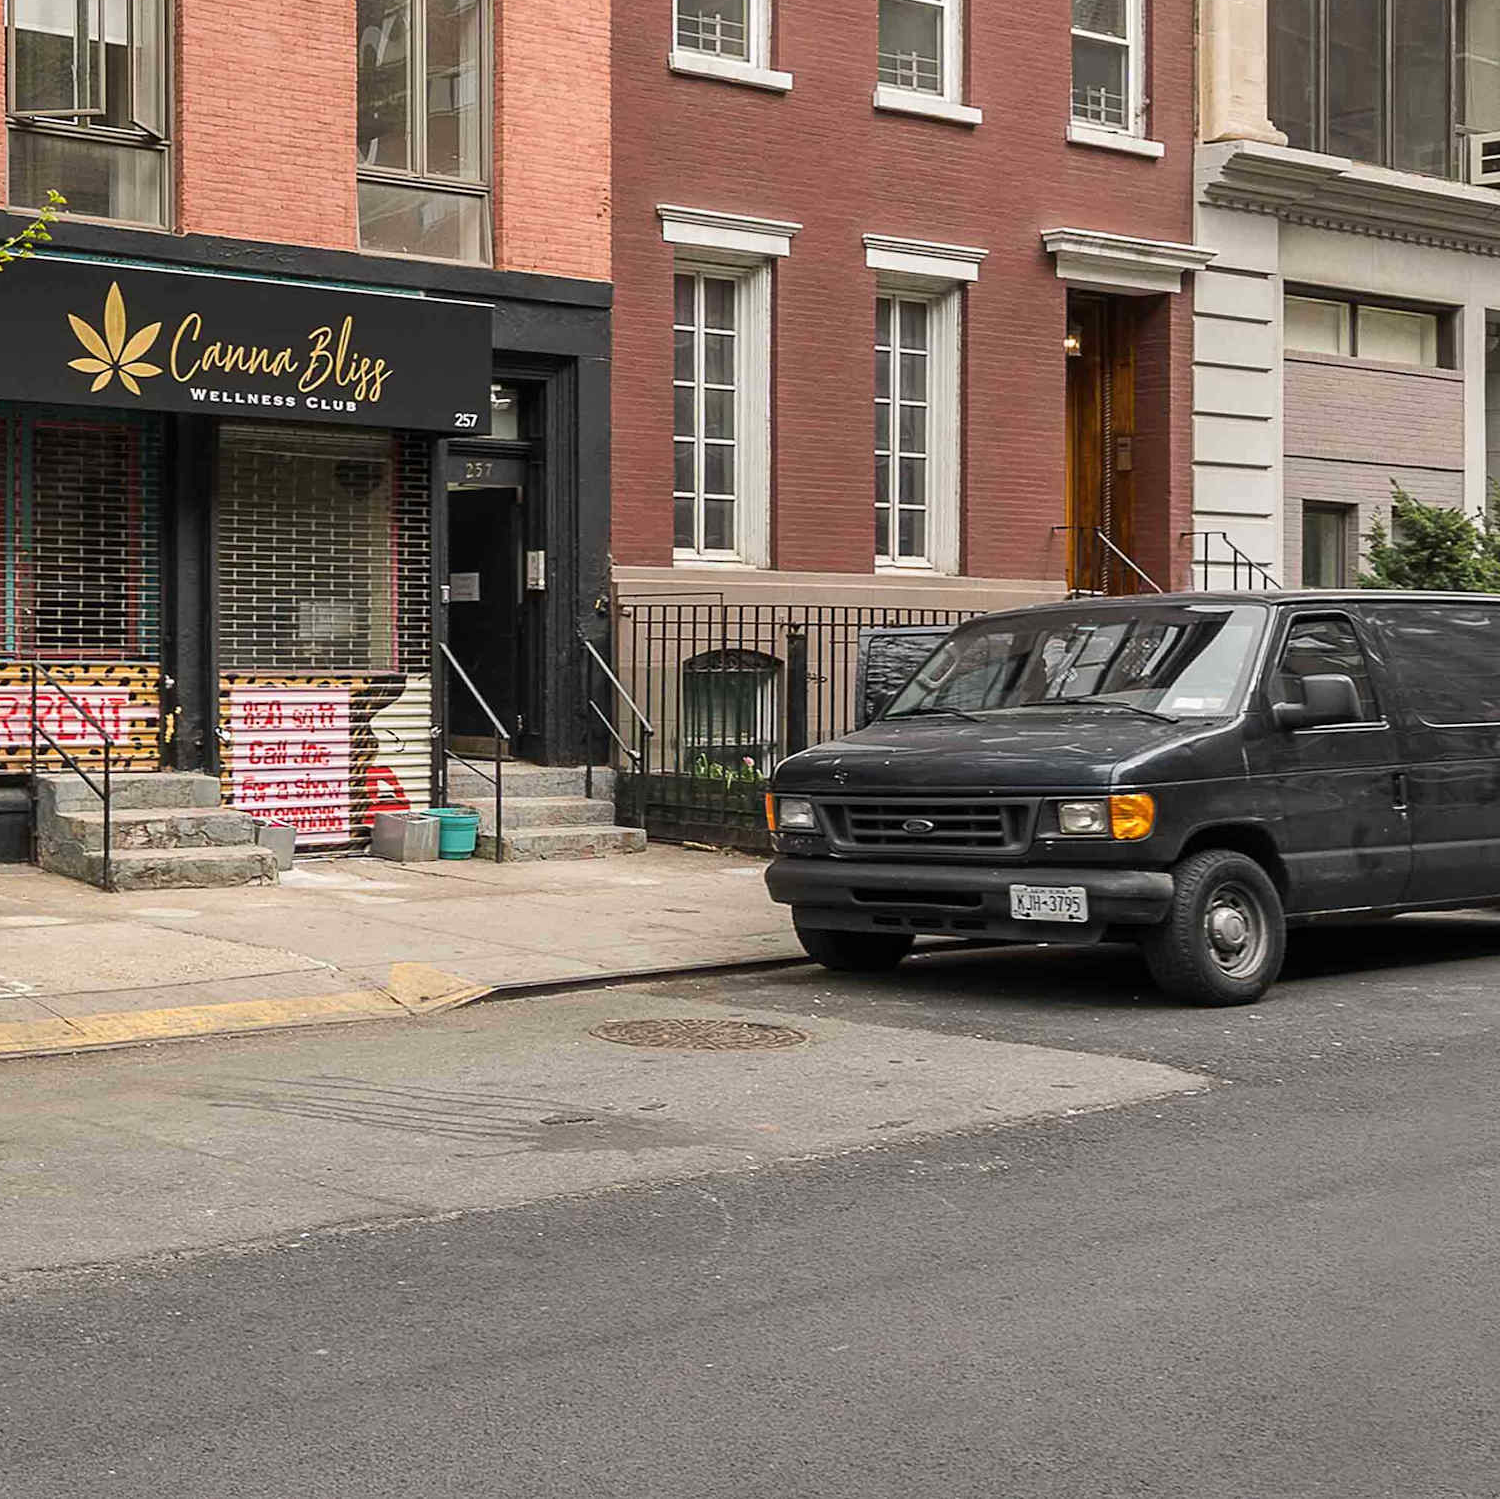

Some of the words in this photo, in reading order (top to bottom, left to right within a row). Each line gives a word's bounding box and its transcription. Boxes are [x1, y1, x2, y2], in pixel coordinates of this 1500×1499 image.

[170, 312, 298, 382] Canna
[298, 315, 394, 402] Bliss
[190, 387, 297, 407] WELLNESS
[306, 397, 357, 412] CLUB
[454, 413, 478, 428] 257
[466, 462, 493, 479] 257
[27, 695, 127, 741] RENT
